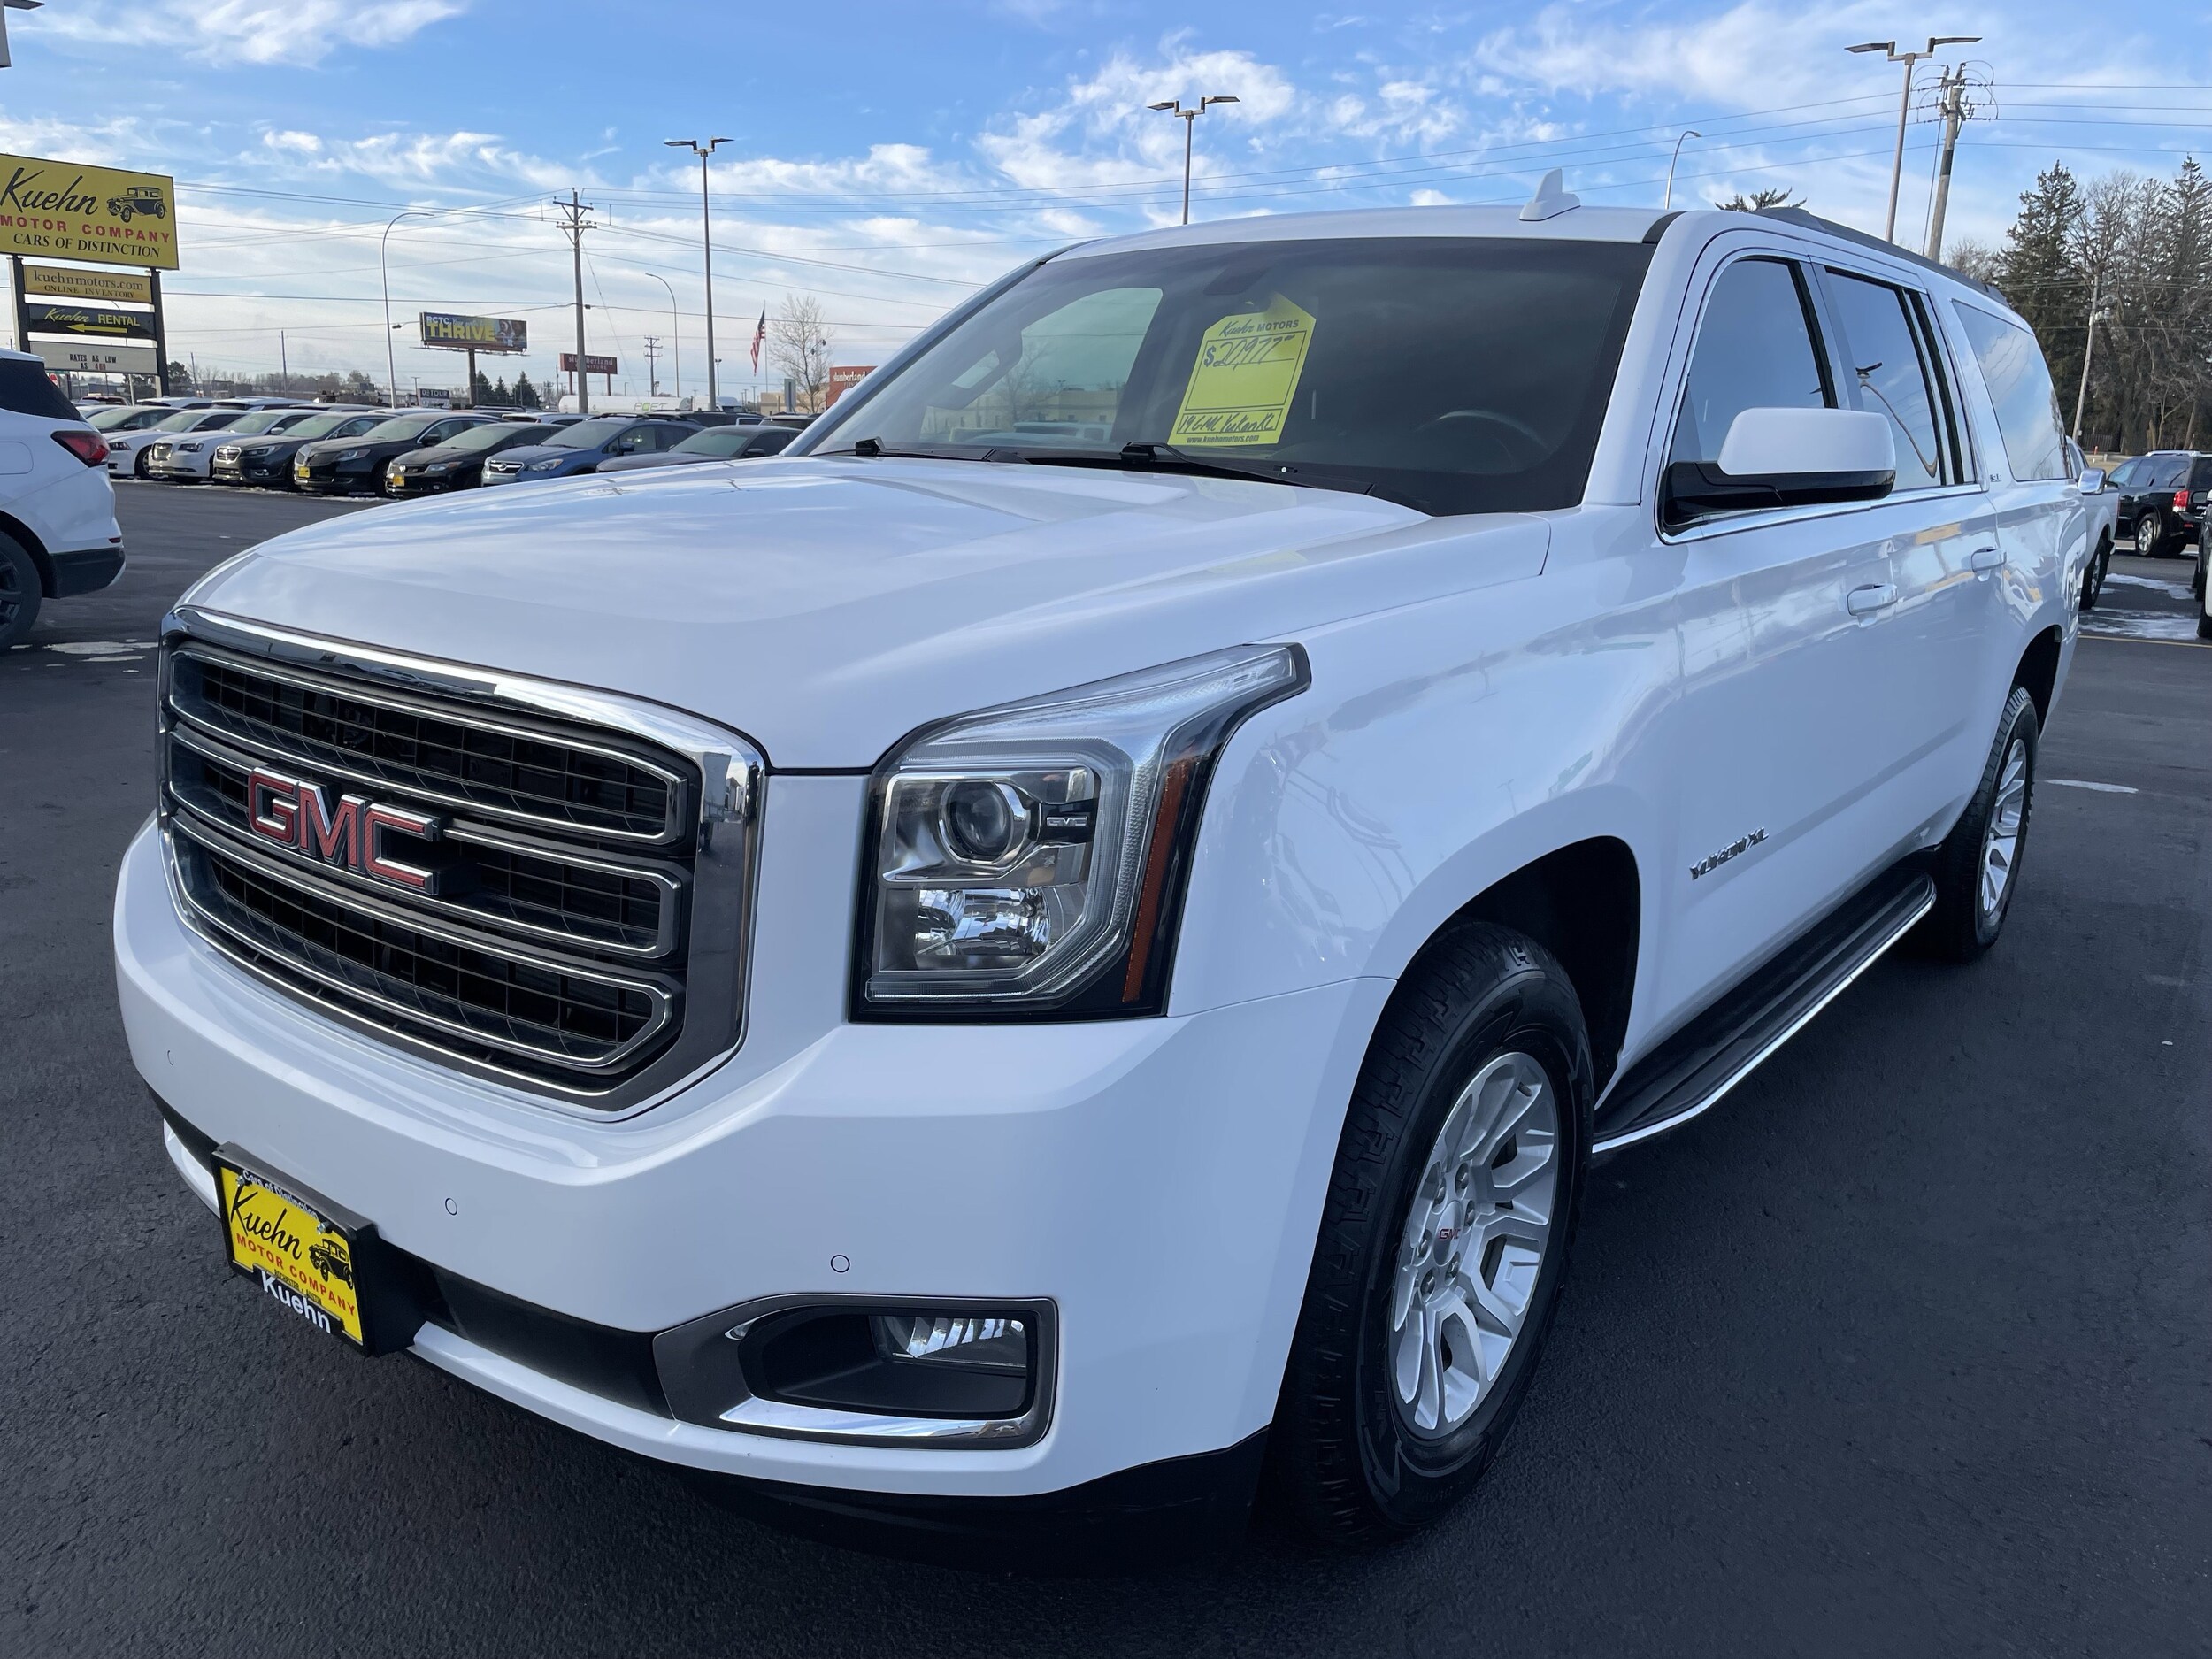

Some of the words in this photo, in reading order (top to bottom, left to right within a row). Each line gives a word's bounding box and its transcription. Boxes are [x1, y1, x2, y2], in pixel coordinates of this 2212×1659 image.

[0, 167, 98, 215] Kuehn
[0, 214, 67, 233] MOTOR
[81, 224, 171, 243] COMPANY
[13, 233, 50, 248] CARS
[55, 237, 73, 249] OF
[77, 239, 160, 258] DISTINCTION
[34, 270, 143, 291] kuehnmotors.com
[44, 285, 79, 294] ONLINE
[85, 288, 135, 299] INVENTORY
[44, 307, 90, 322] Kuehn
[97, 313, 141, 326] RENTAL
[1219, 319, 1255, 337] Kuehn
[1256, 319, 1300, 333] MOTORS
[69, 353, 88, 362] RATES
[104, 355, 117, 364] LOW
[567, 355, 613, 365] slberland
[249, 766, 438, 896] GMC
[1046, 816, 1088, 827] GMC
[1688, 836, 1747, 881] YUKON
[1746, 826, 1770, 850] XL
[230, 1184, 303, 1260] Kuehn
[236, 1233, 284, 1270] MOTOR
[289, 1264, 356, 1317] COMPANY
[261, 1270, 332, 1334] Kuehn
